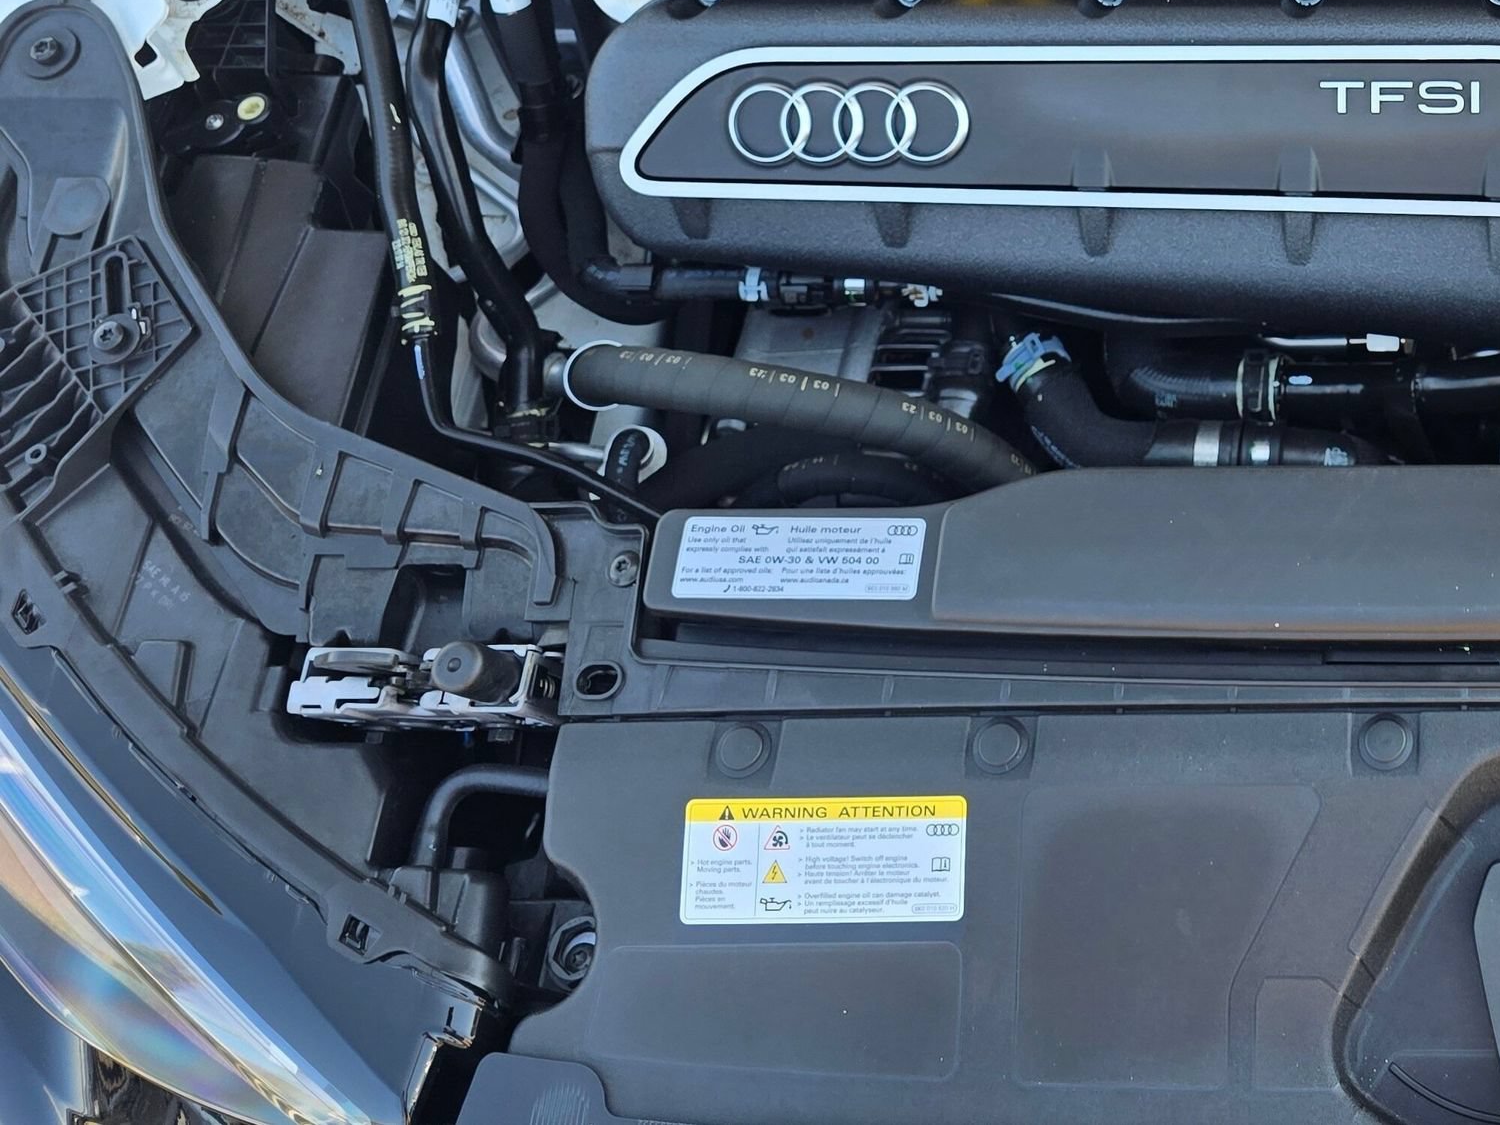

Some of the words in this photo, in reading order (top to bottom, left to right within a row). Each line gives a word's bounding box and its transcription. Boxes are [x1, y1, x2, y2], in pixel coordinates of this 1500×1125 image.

[1319, 80, 1480, 115] TFSI
[691, 524, 727, 534] Engine
[730, 525, 746, 533] Oil
[790, 525, 817, 534] Huile
[821, 526, 862, 534] moteur
[738, 555, 761, 564] SAE
[764, 556, 802, 564] 0W-30
[804, 556, 814, 564] &
[818, 556, 839, 565] VW
[841, 556, 862, 565] 504
[865, 557, 880, 565] 00
[741, 807, 828, 819] WARNING
[838, 805, 936, 818] ATTENTION
[710, 859, 733, 867] engine
[697, 866, 721, 874] Moving
